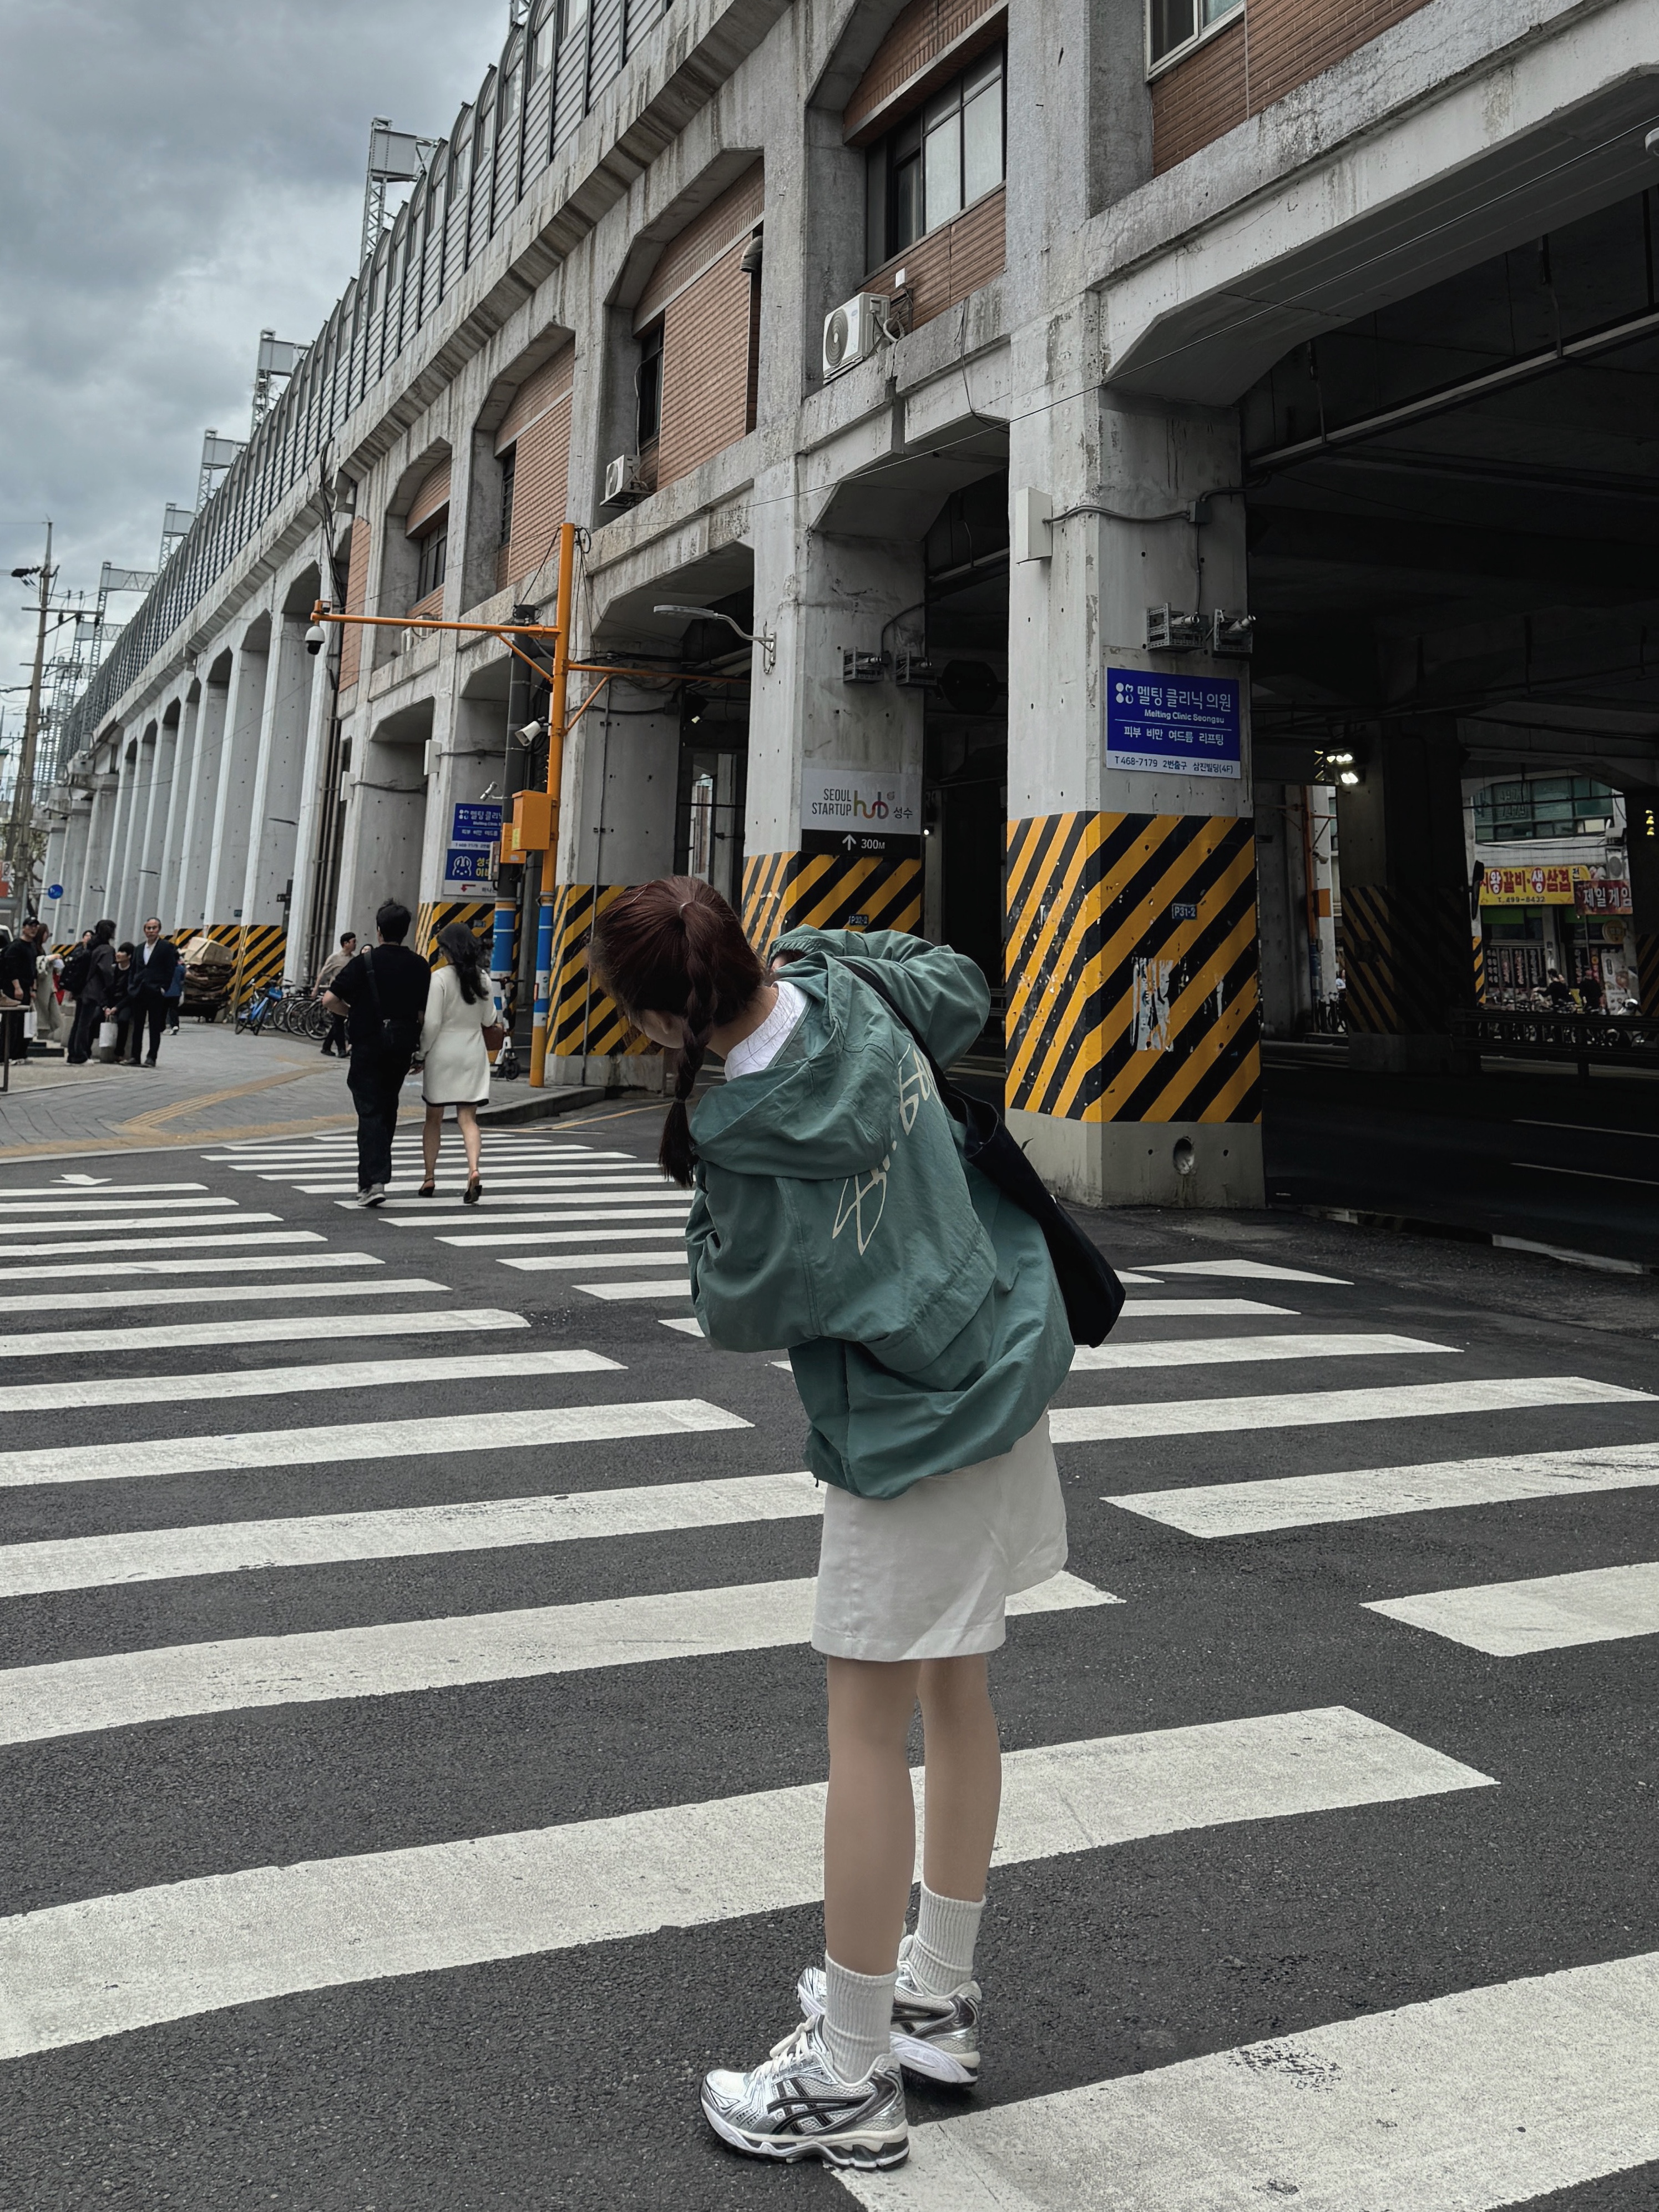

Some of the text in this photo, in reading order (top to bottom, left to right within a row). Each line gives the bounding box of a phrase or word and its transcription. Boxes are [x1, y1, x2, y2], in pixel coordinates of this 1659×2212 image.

[1137, 686, 1230, 711] 멜팅 클리닉 의원
[1145, 709, 1224, 723] Melting Clinic Seongsu
[1124, 726, 1223, 745] 피부 비만 여드름 리프팅
[1163, 760, 1187, 770] 2번출구
[1193, 762, 1233, 774] 삼진빌딩(4F)
[823, 788, 851, 801] SEOUL
[812, 802, 851, 815] STARTUP
[853, 790, 888, 819] hub
[893, 806, 913, 819] 성수
[1175, 906, 1196, 917] P31-2
